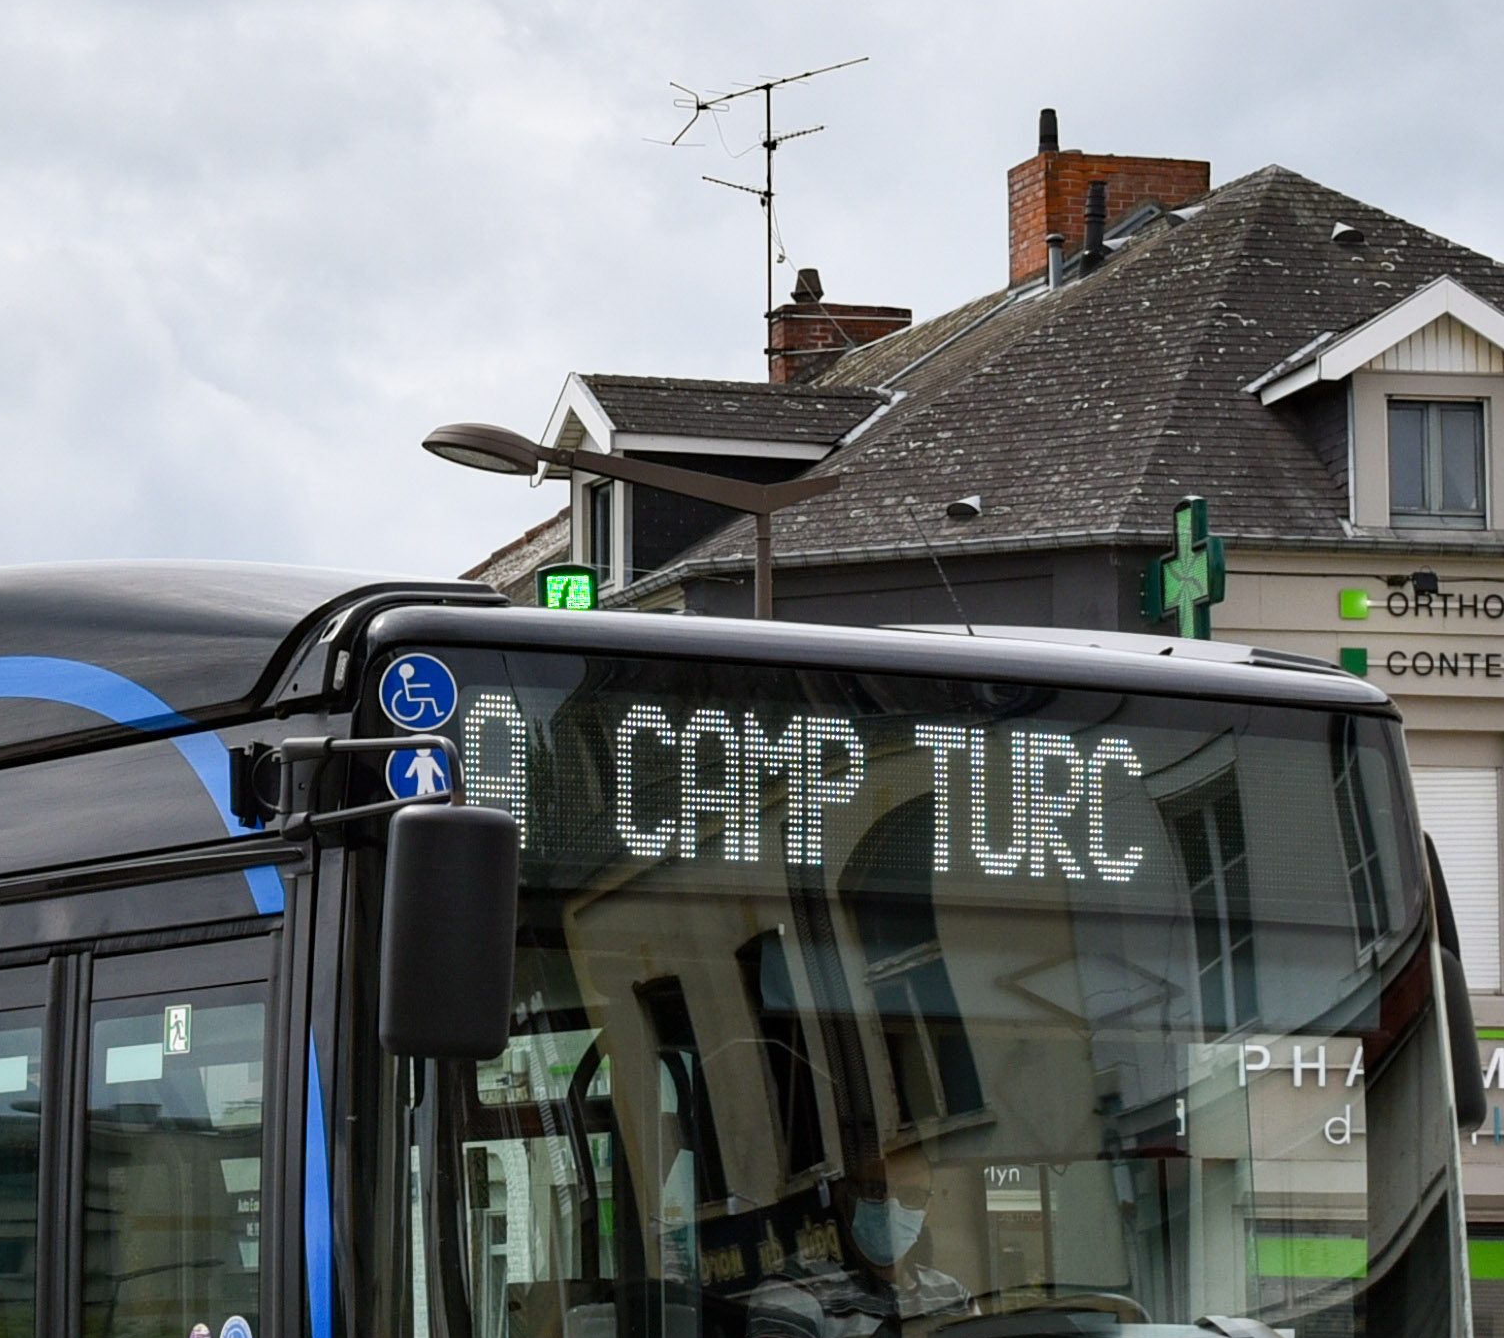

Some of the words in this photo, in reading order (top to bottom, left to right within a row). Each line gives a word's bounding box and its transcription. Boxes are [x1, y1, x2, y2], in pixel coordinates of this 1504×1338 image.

[465, 693, 527, 850] A
[617, 704, 865, 866] CAMP
[914, 724, 1143, 882] TURC
